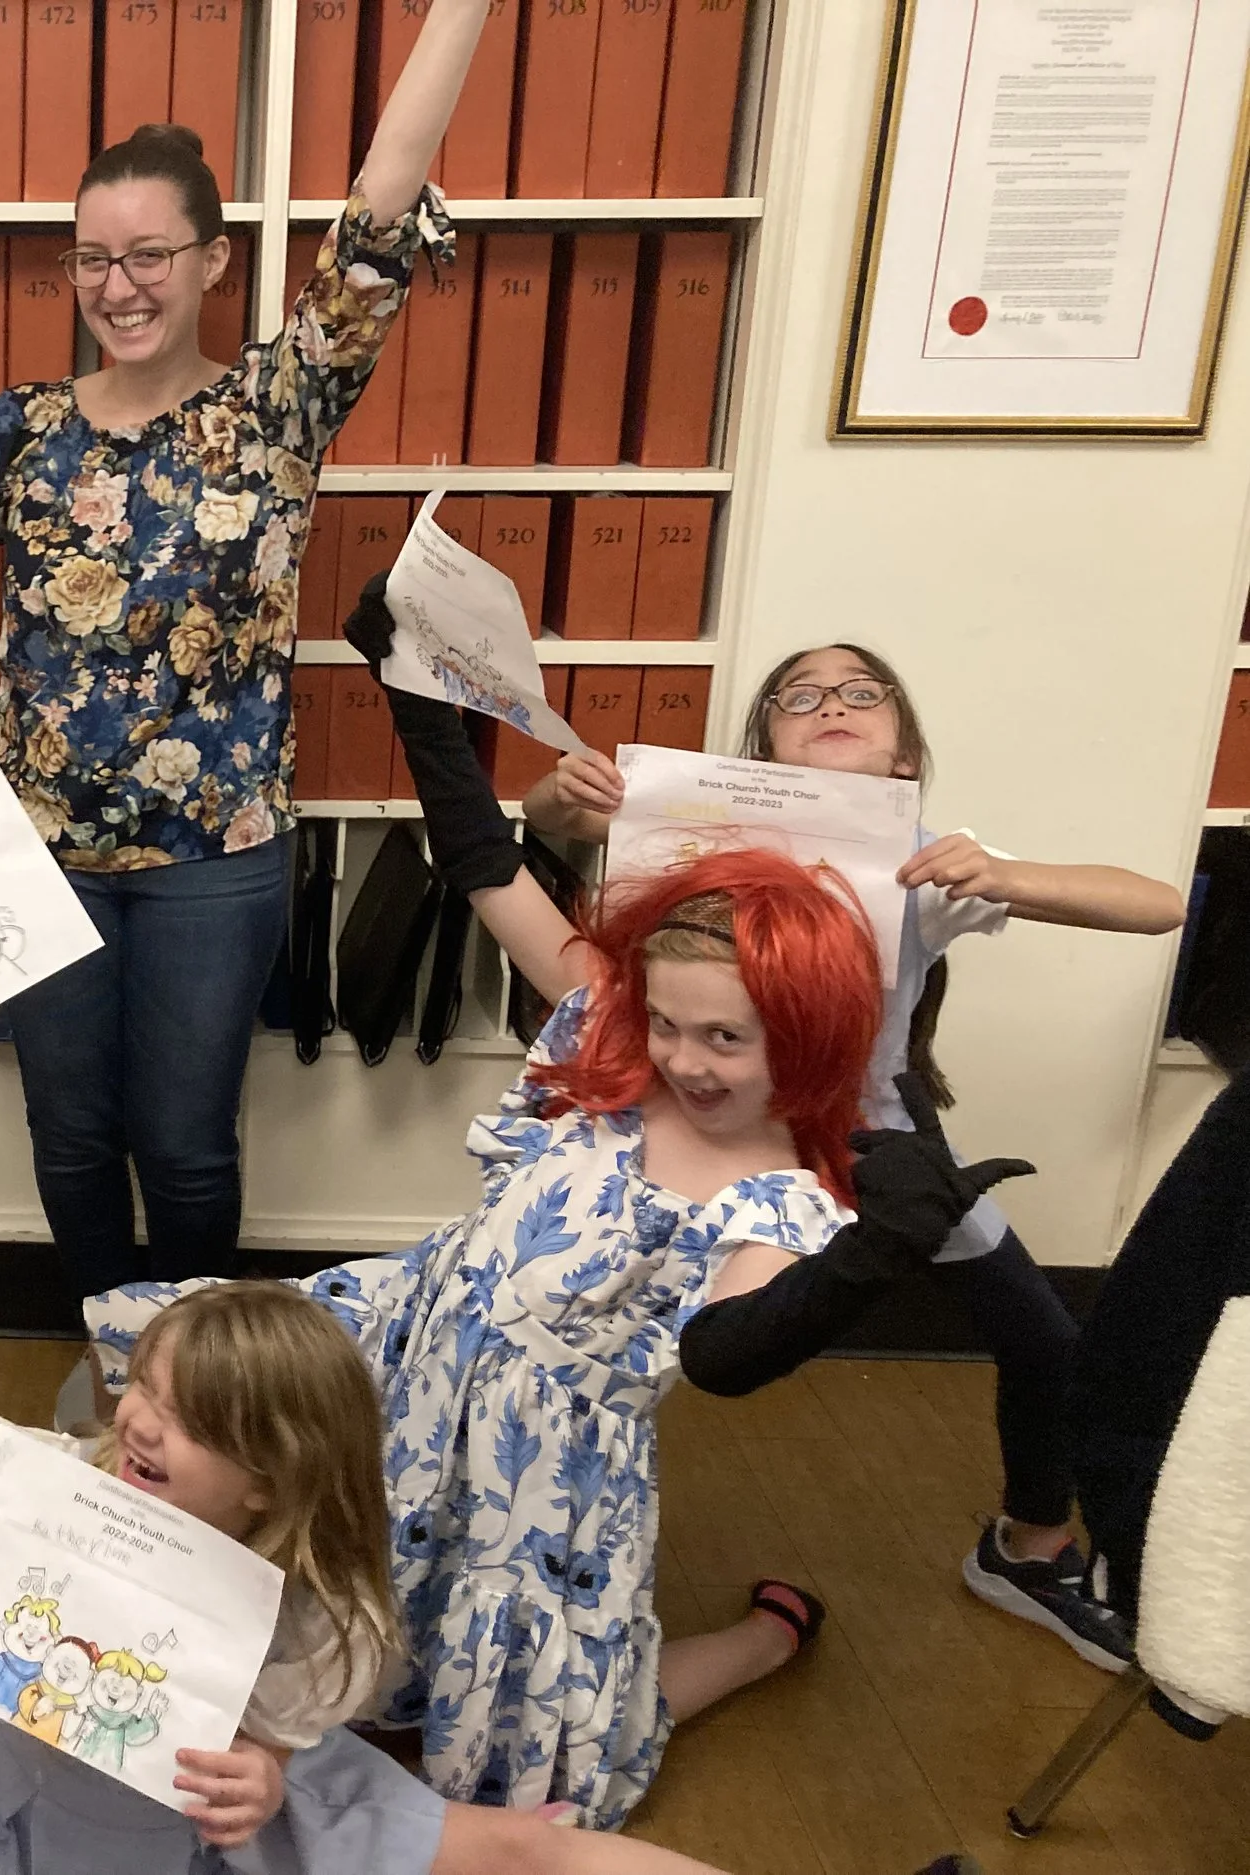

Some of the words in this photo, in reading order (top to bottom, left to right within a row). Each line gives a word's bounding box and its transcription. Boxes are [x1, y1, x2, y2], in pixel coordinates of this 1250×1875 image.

[39, 5, 75, 24] 472
[121, 3, 158, 26] 473
[190, 4, 227, 22] 474
[400, 0, 427, 23] 50
[24, 280, 60, 298] 478
[500, 278, 531, 297] 514
[591, 277, 618, 297] 515
[676, 278, 710, 298] 516
[357, 526, 389, 546] 518
[496, 527, 536, 546] 520
[592, 527, 623, 547] 521
[657, 526, 692, 547] 522
[345, 692, 380, 709] 524
[588, 694, 623, 713] 527
[657, 693, 691, 714] 528
[698, 778, 723, 789] Brick
[725, 782, 761, 794] Church
[763, 786, 791, 797] Youth
[793, 790, 820, 801] Choir
[294, 804, 302, 814] 6
[376, 804, 385, 814] 7
[732, 795, 783, 808] 2022-2023
[74, 1492, 99, 1511] Brick
[101, 1506, 136, 1529] Church
[139, 1522, 165, 1542] Youth
[167, 1537, 194, 1556] Choir
[103, 1524, 154, 1554] 2022-2023
